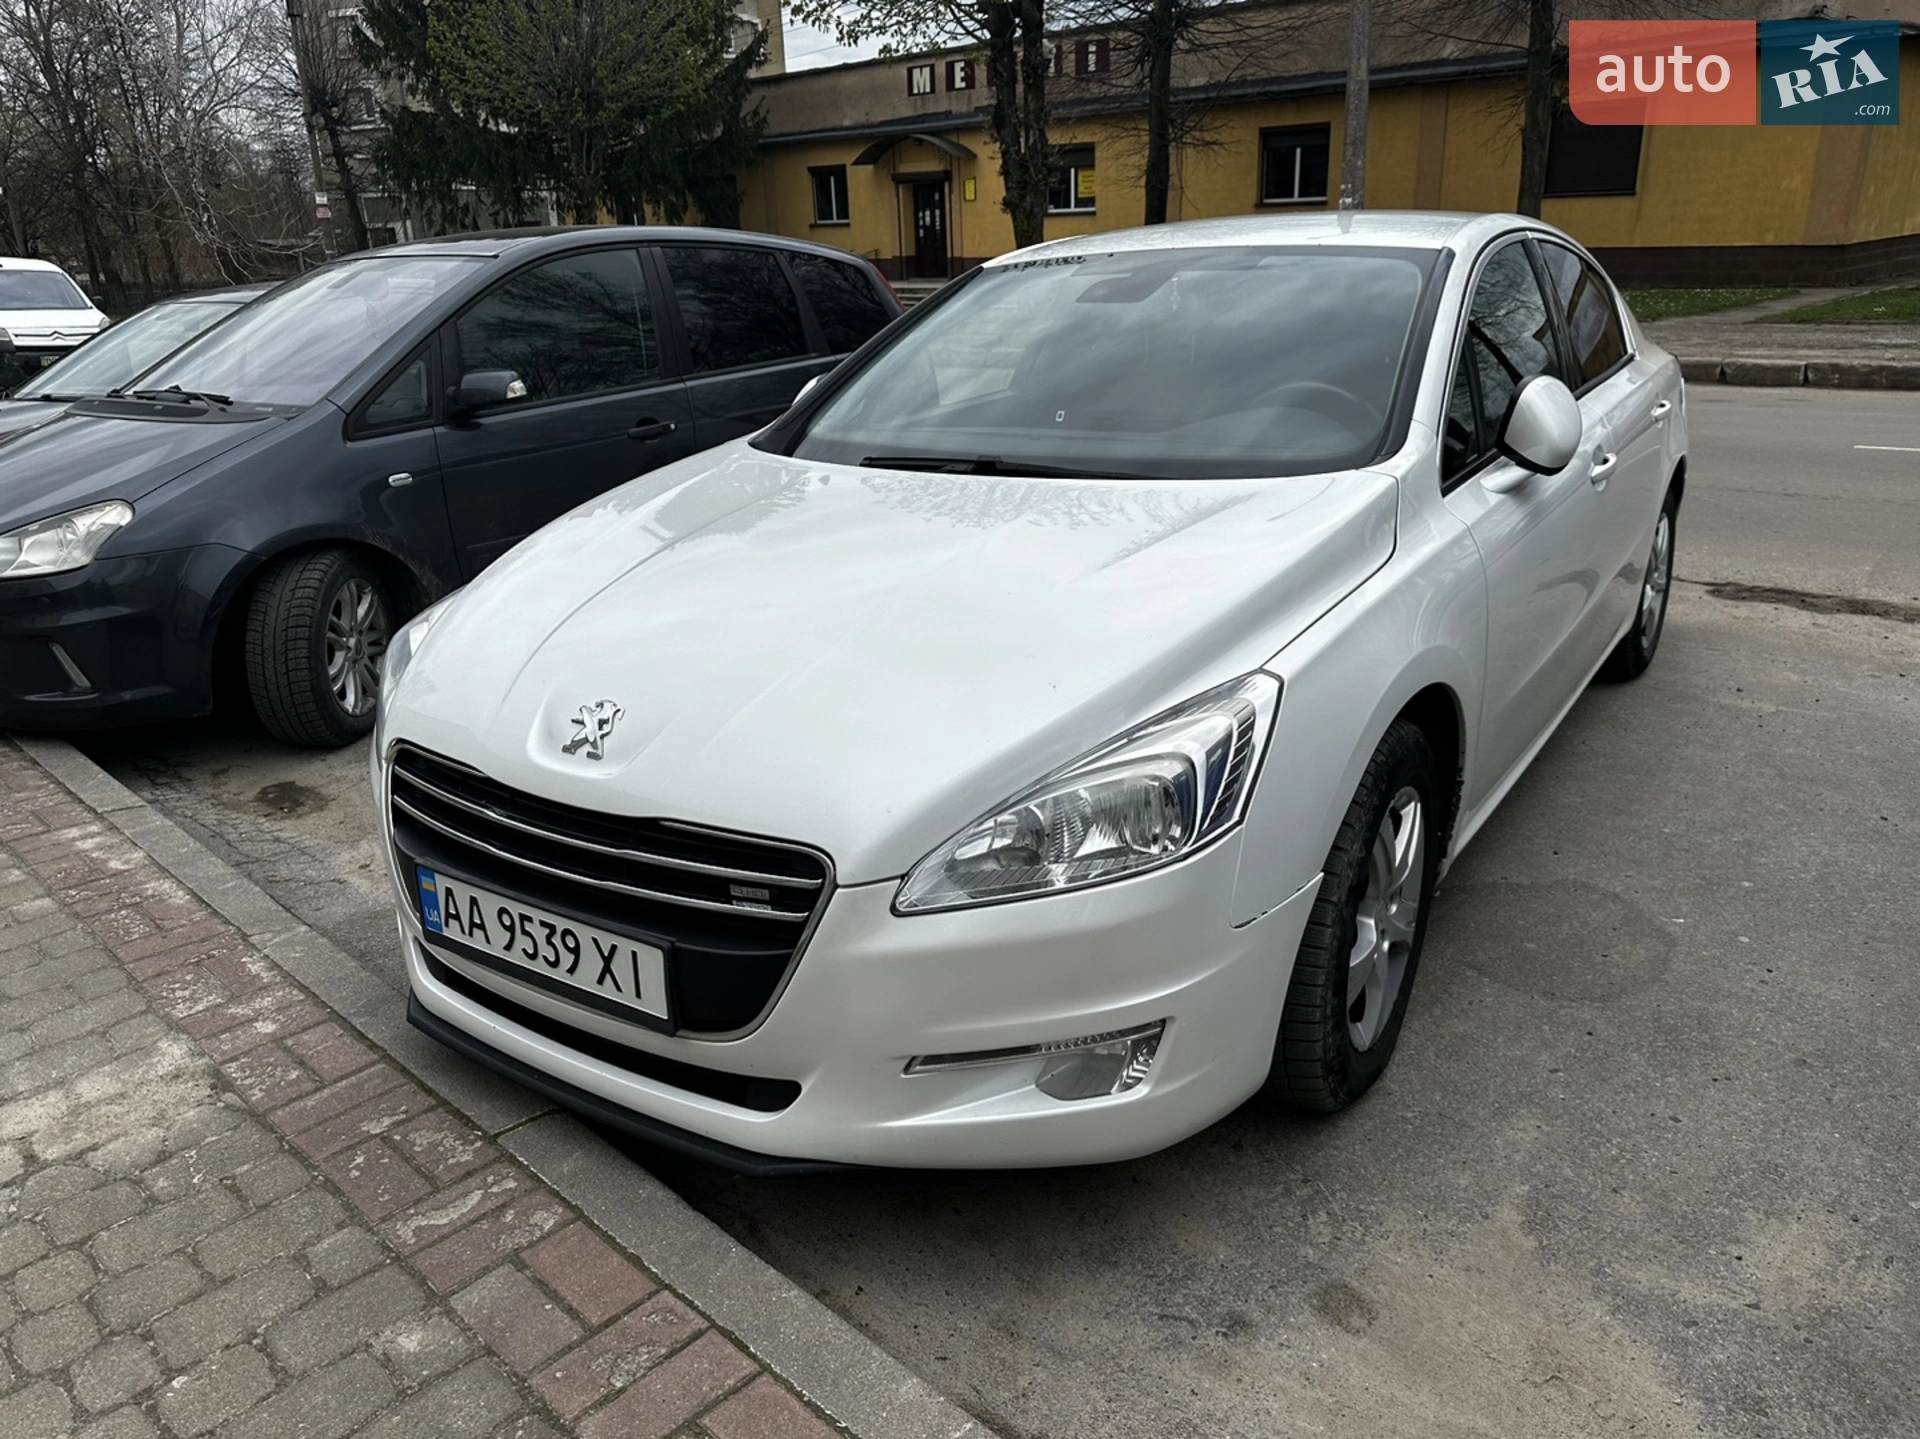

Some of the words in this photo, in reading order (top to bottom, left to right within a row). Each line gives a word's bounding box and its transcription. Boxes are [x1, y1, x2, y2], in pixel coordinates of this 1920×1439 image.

[424, 906, 441, 924] UA
[443, 885, 491, 945] AA
[496, 906, 582, 977] 9539
